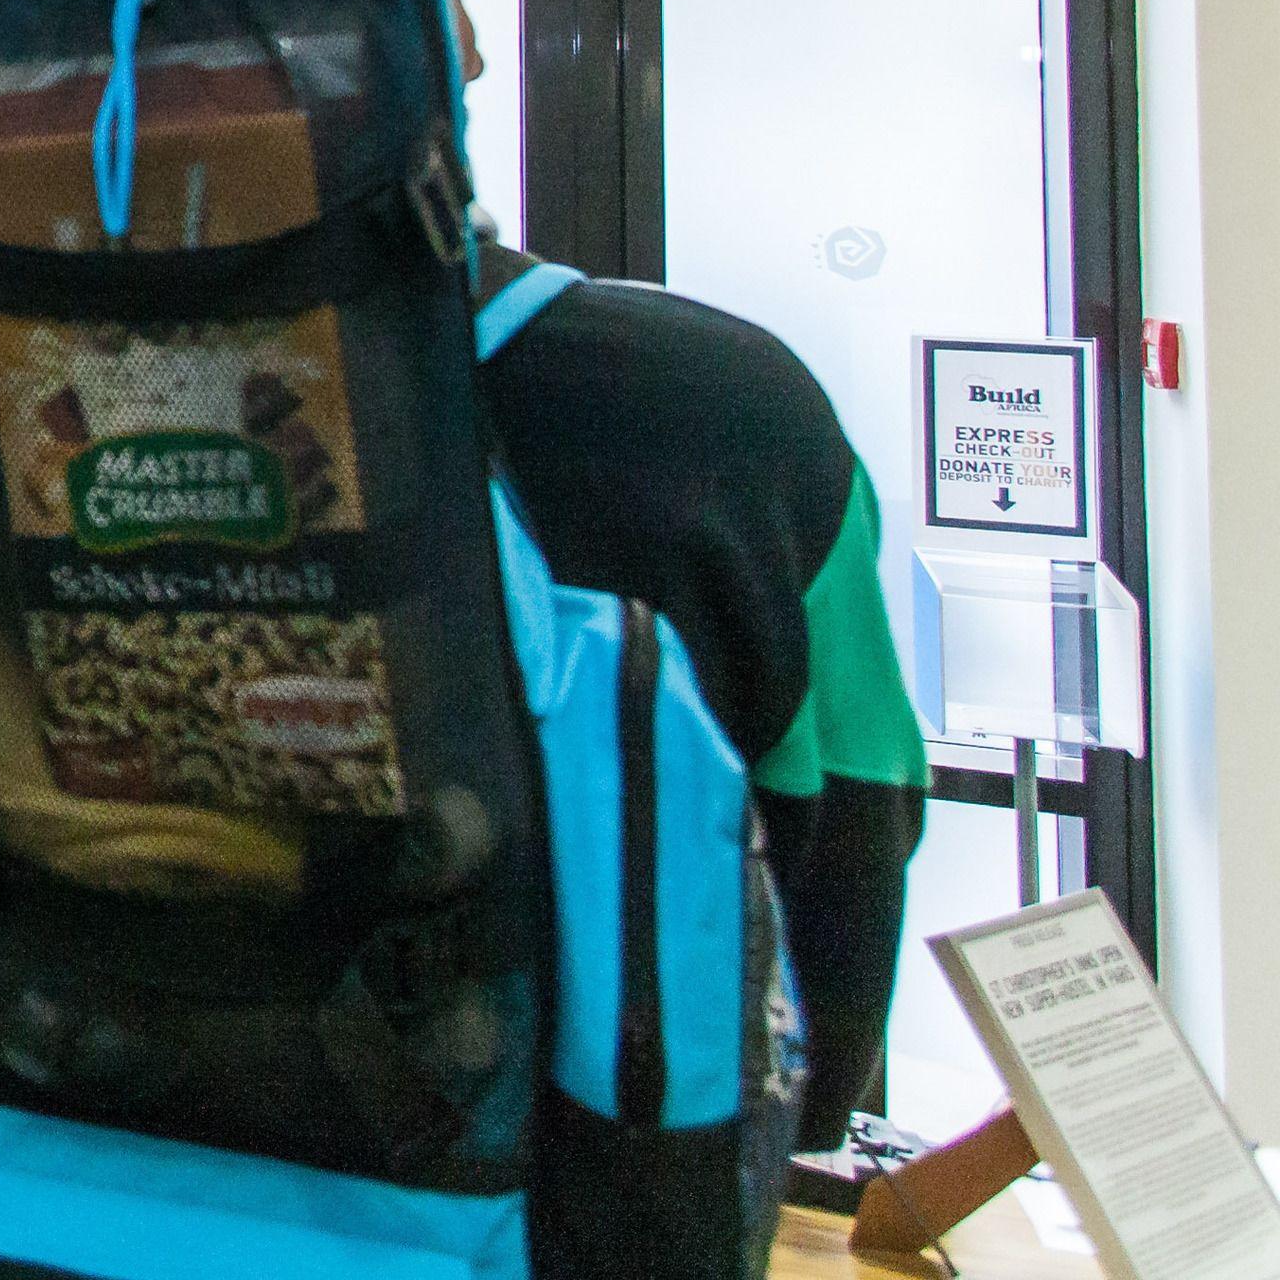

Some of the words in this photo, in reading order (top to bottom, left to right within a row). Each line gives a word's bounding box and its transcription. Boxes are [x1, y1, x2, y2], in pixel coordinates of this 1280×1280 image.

[968, 385, 1042, 405] Build
[997, 403, 1042, 414] AFRICA
[955, 426, 1055, 446] EXPRESS
[954, 443, 1056, 460] CHECK-OUT
[95, 446, 254, 487] MASTER
[940, 459, 1014, 476] DONATE
[1020, 463, 1072, 479] YOUR
[939, 471, 993, 484] DEPOSIT
[997, 475, 1013, 485] TO
[1016, 476, 1072, 489] CHARITY
